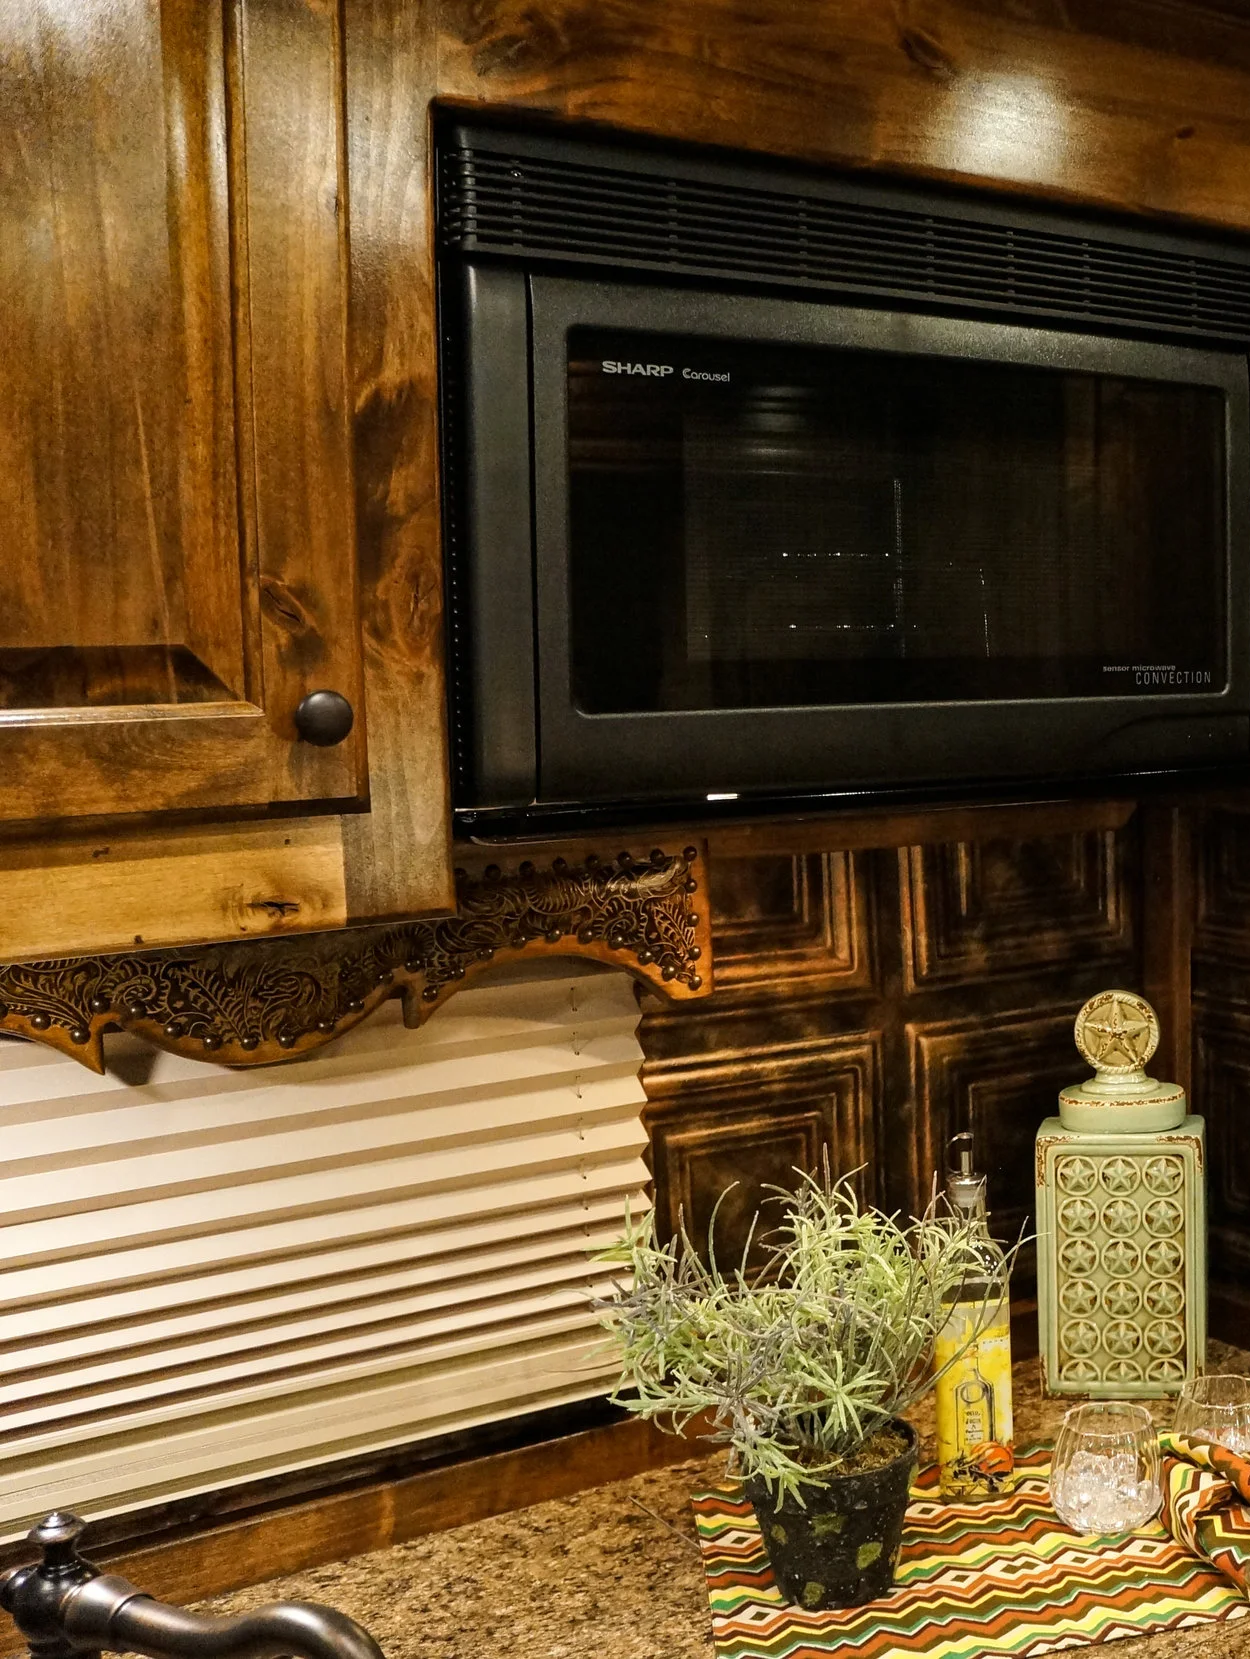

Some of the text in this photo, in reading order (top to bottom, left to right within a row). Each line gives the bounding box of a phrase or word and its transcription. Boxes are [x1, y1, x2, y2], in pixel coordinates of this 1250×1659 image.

[602, 360, 730, 383] SHARP Carousel
[1132, 664, 1176, 672] microwave
[1135, 671, 1211, 685] CONVECTION
